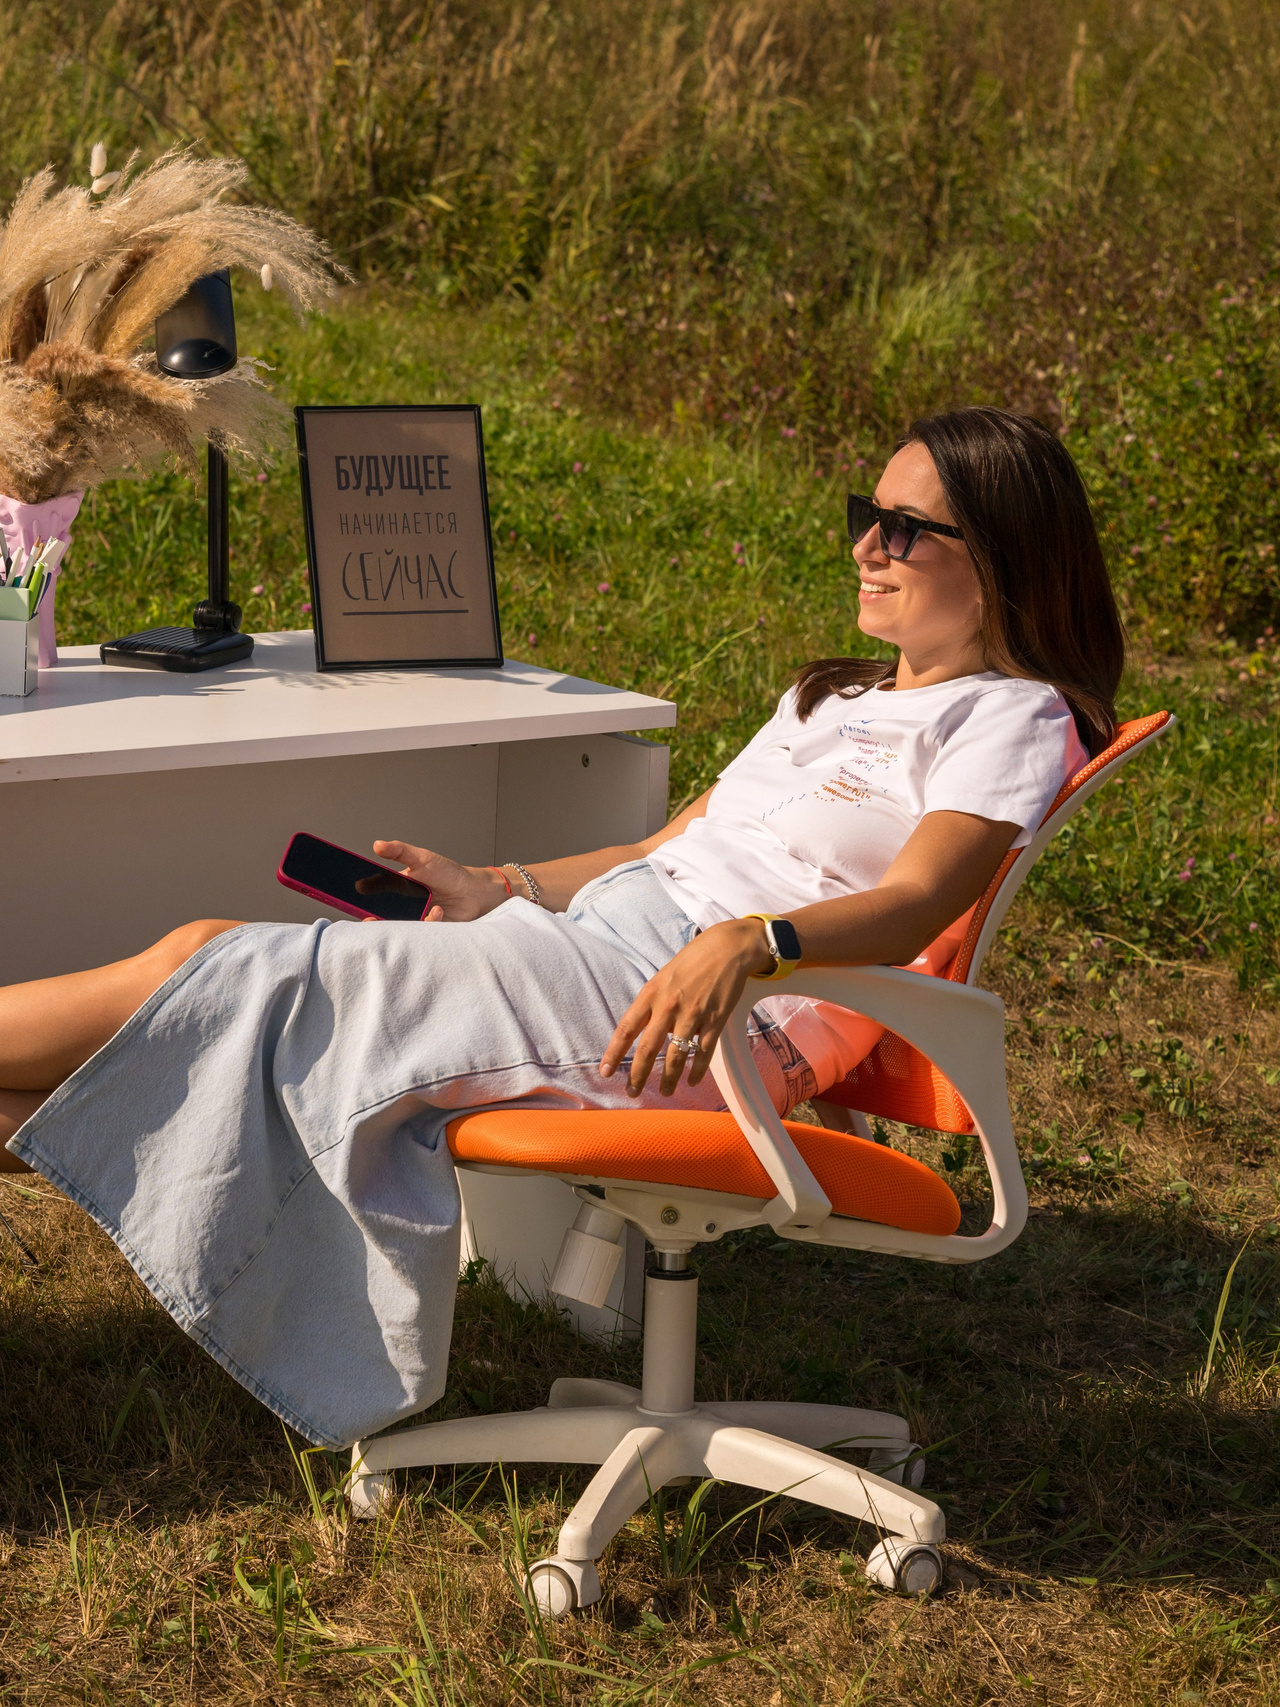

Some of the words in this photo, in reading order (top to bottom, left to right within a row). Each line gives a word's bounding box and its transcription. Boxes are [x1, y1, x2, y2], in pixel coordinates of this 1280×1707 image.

[334, 455, 452, 497] БУДУЩЕЕ
[339, 511, 458, 535] НАЧИНАЕТСЯ
[341, 548, 465, 602] СЕЙЧАС
